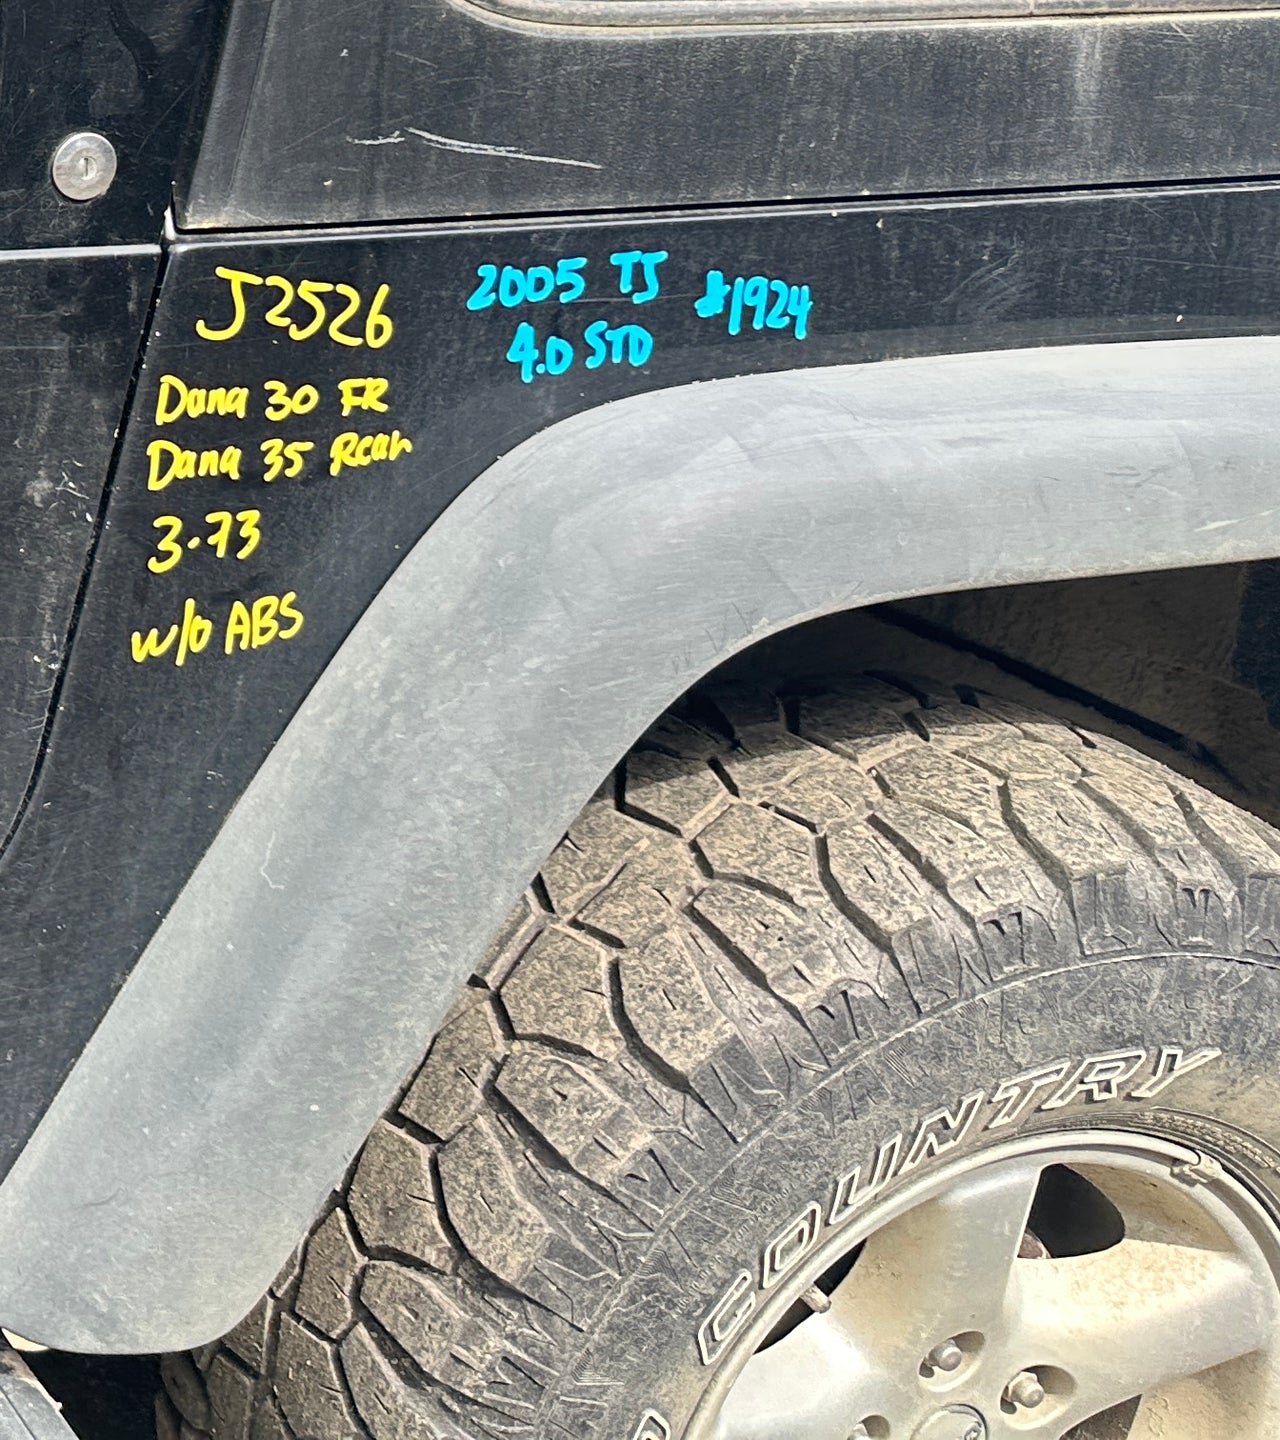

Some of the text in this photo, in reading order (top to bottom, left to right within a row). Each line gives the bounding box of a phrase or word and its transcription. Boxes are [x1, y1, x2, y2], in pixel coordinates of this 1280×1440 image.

[194, 266, 394, 349] J2526
[466, 257, 589, 311] 2005
[609, 250, 669, 304] TJ
[506, 320, 654, 384] 4.0 STD
[155, 374, 390, 426] Dana 30 FR
[146, 439, 242, 491] Dana
[260, 438, 314, 482] 35
[224, 591, 305, 655] ABS
[697, 1047, 1223, 1366] COUNTRY
